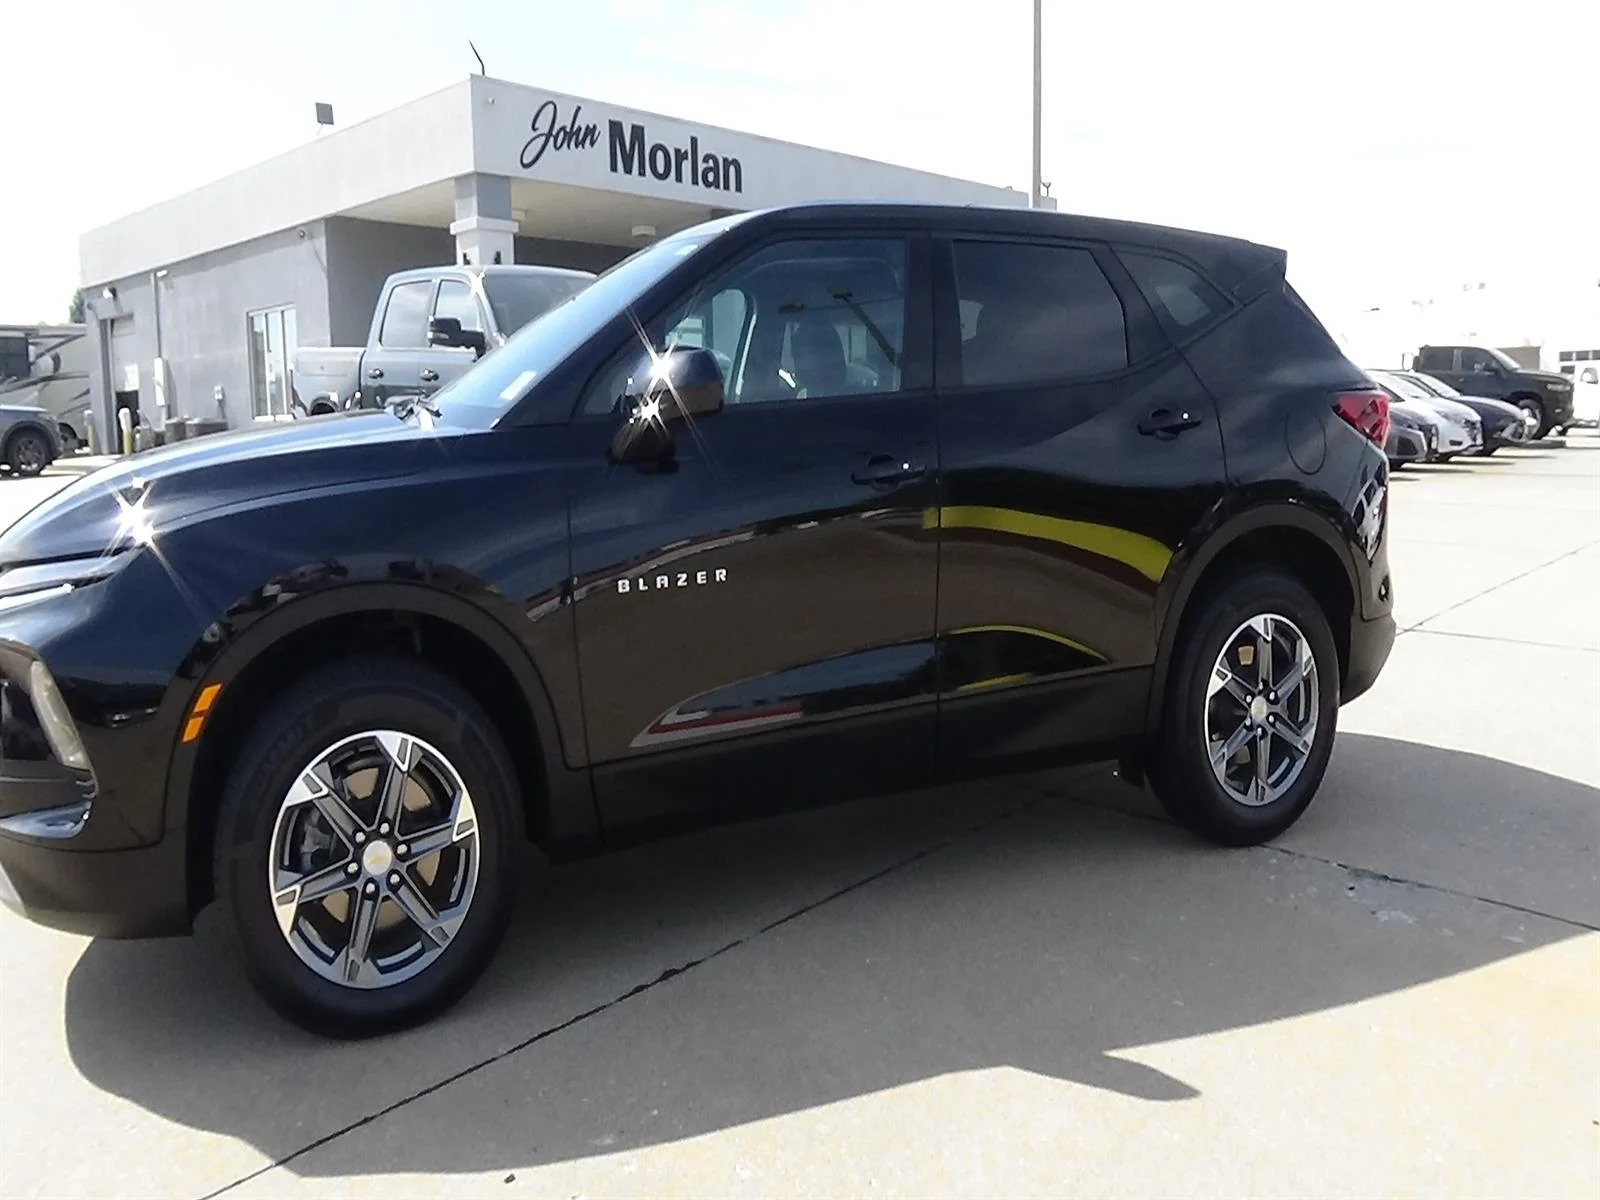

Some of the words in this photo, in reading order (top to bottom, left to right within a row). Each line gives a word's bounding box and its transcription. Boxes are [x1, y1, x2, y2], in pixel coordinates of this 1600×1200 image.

[520, 100, 601, 169] John
[608, 119, 743, 193] Morlan
[617, 568, 727, 594] BLAZER
